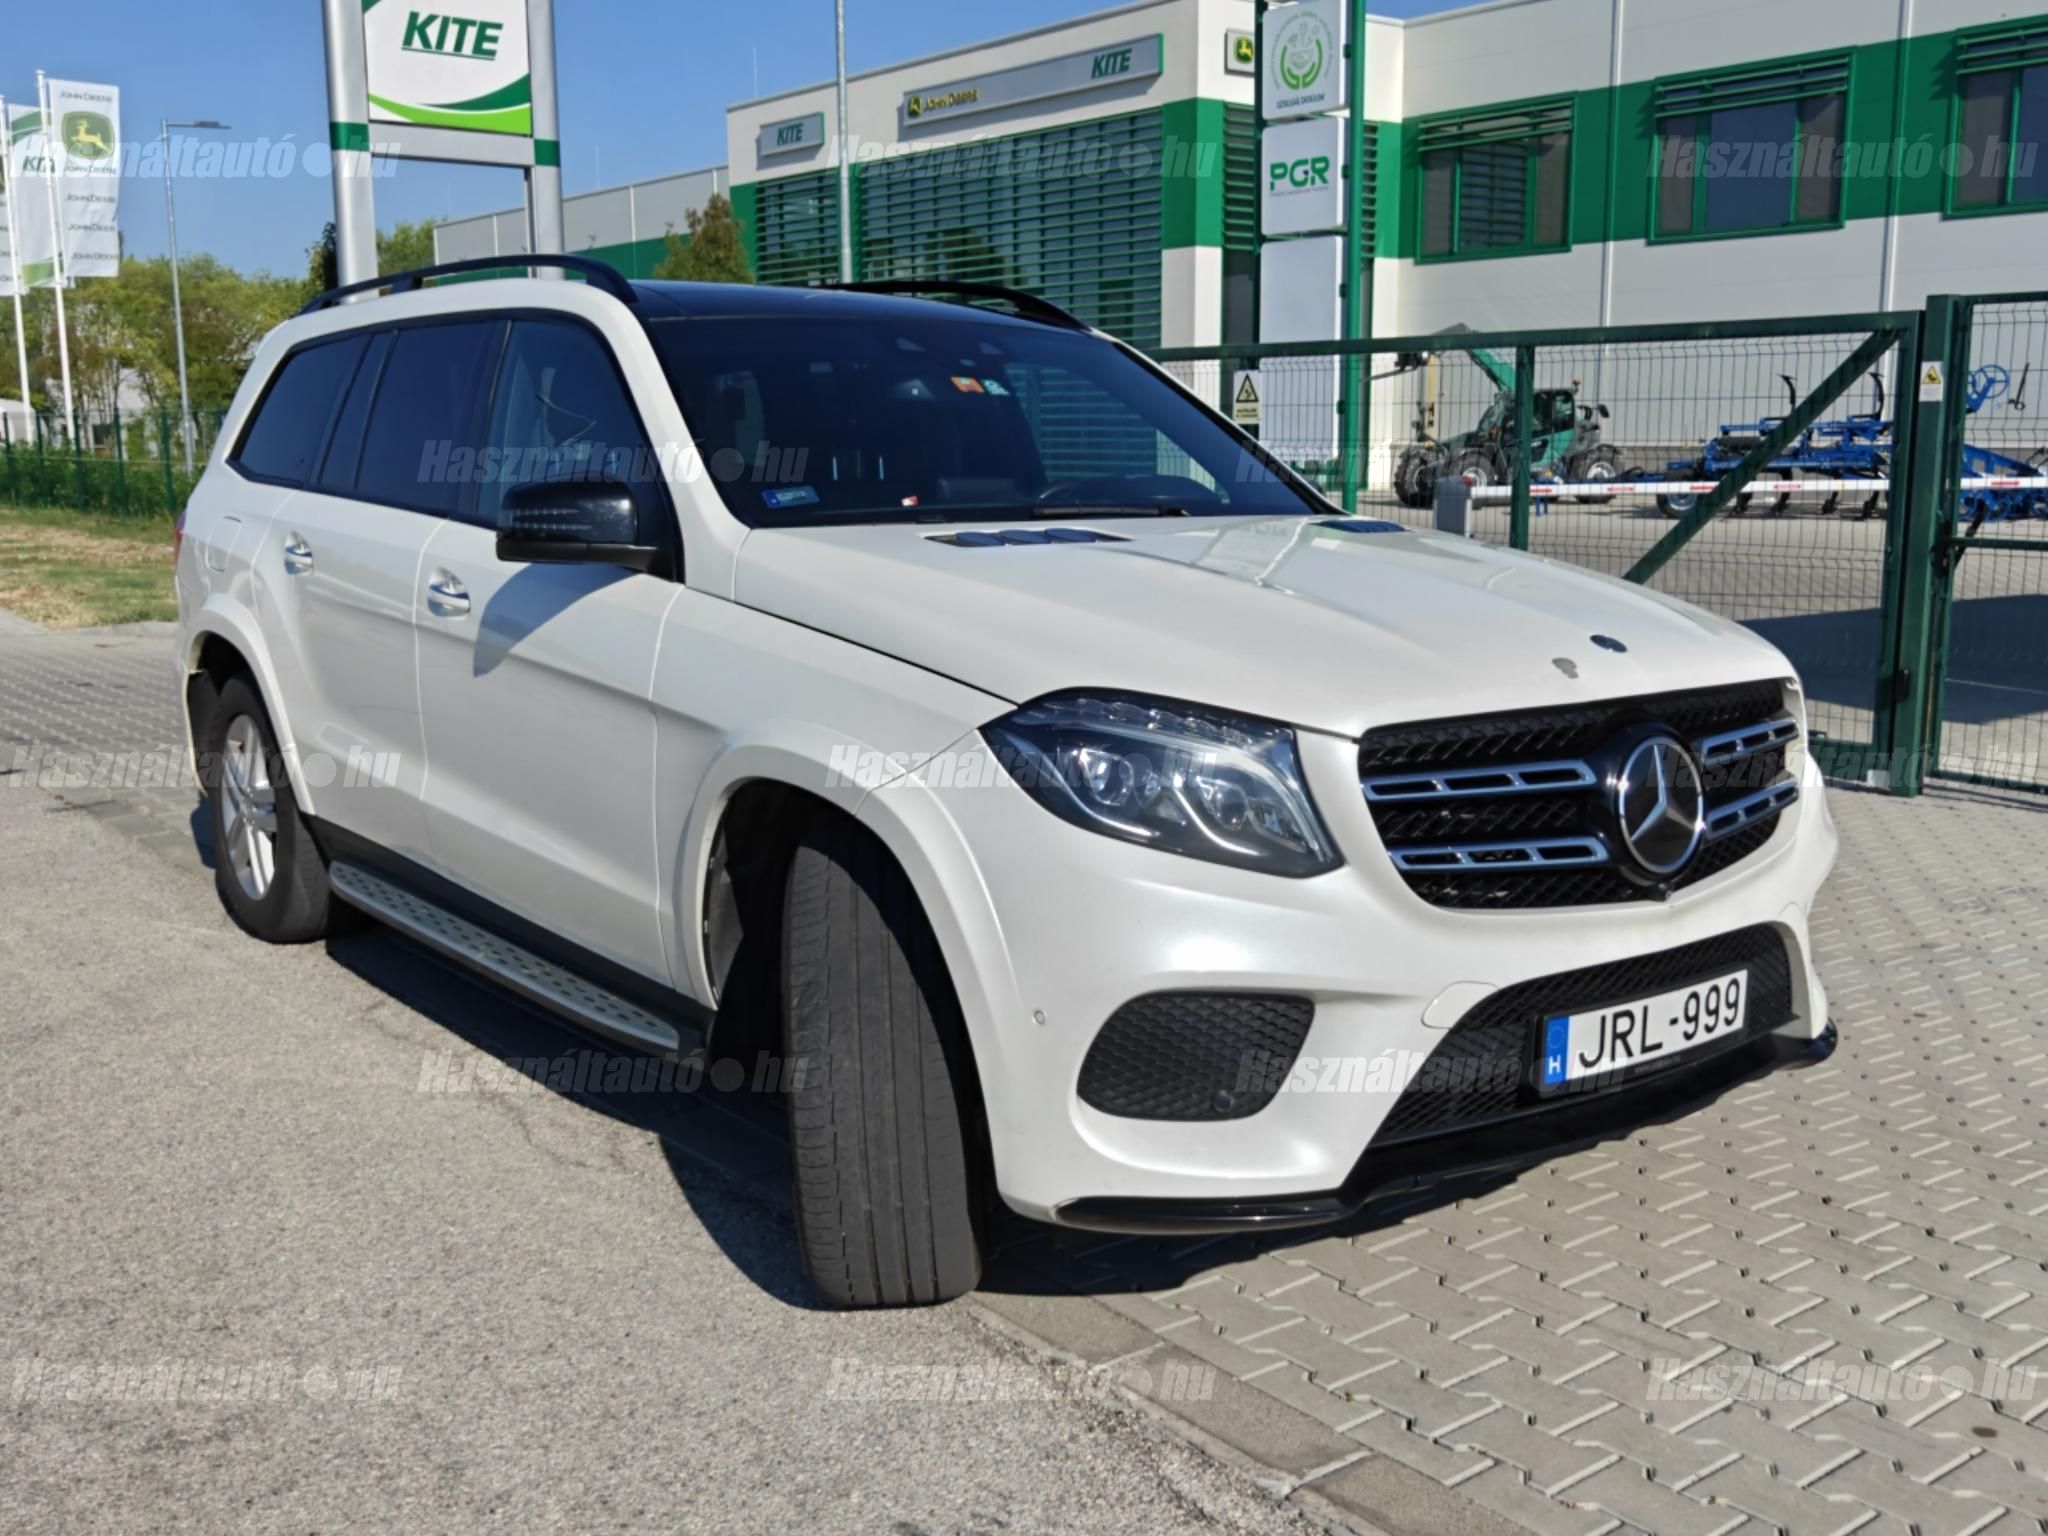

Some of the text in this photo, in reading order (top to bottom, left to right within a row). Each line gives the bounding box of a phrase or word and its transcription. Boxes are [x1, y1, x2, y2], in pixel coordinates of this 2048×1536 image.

[402, 10, 503, 58] KITE
[1091, 47, 1132, 79] KITE
[776, 122, 804, 146] KITE
[1270, 155, 1329, 191] PGR
[1578, 977, 1740, 1069] JRL-999
[1548, 1056, 1561, 1075] H
